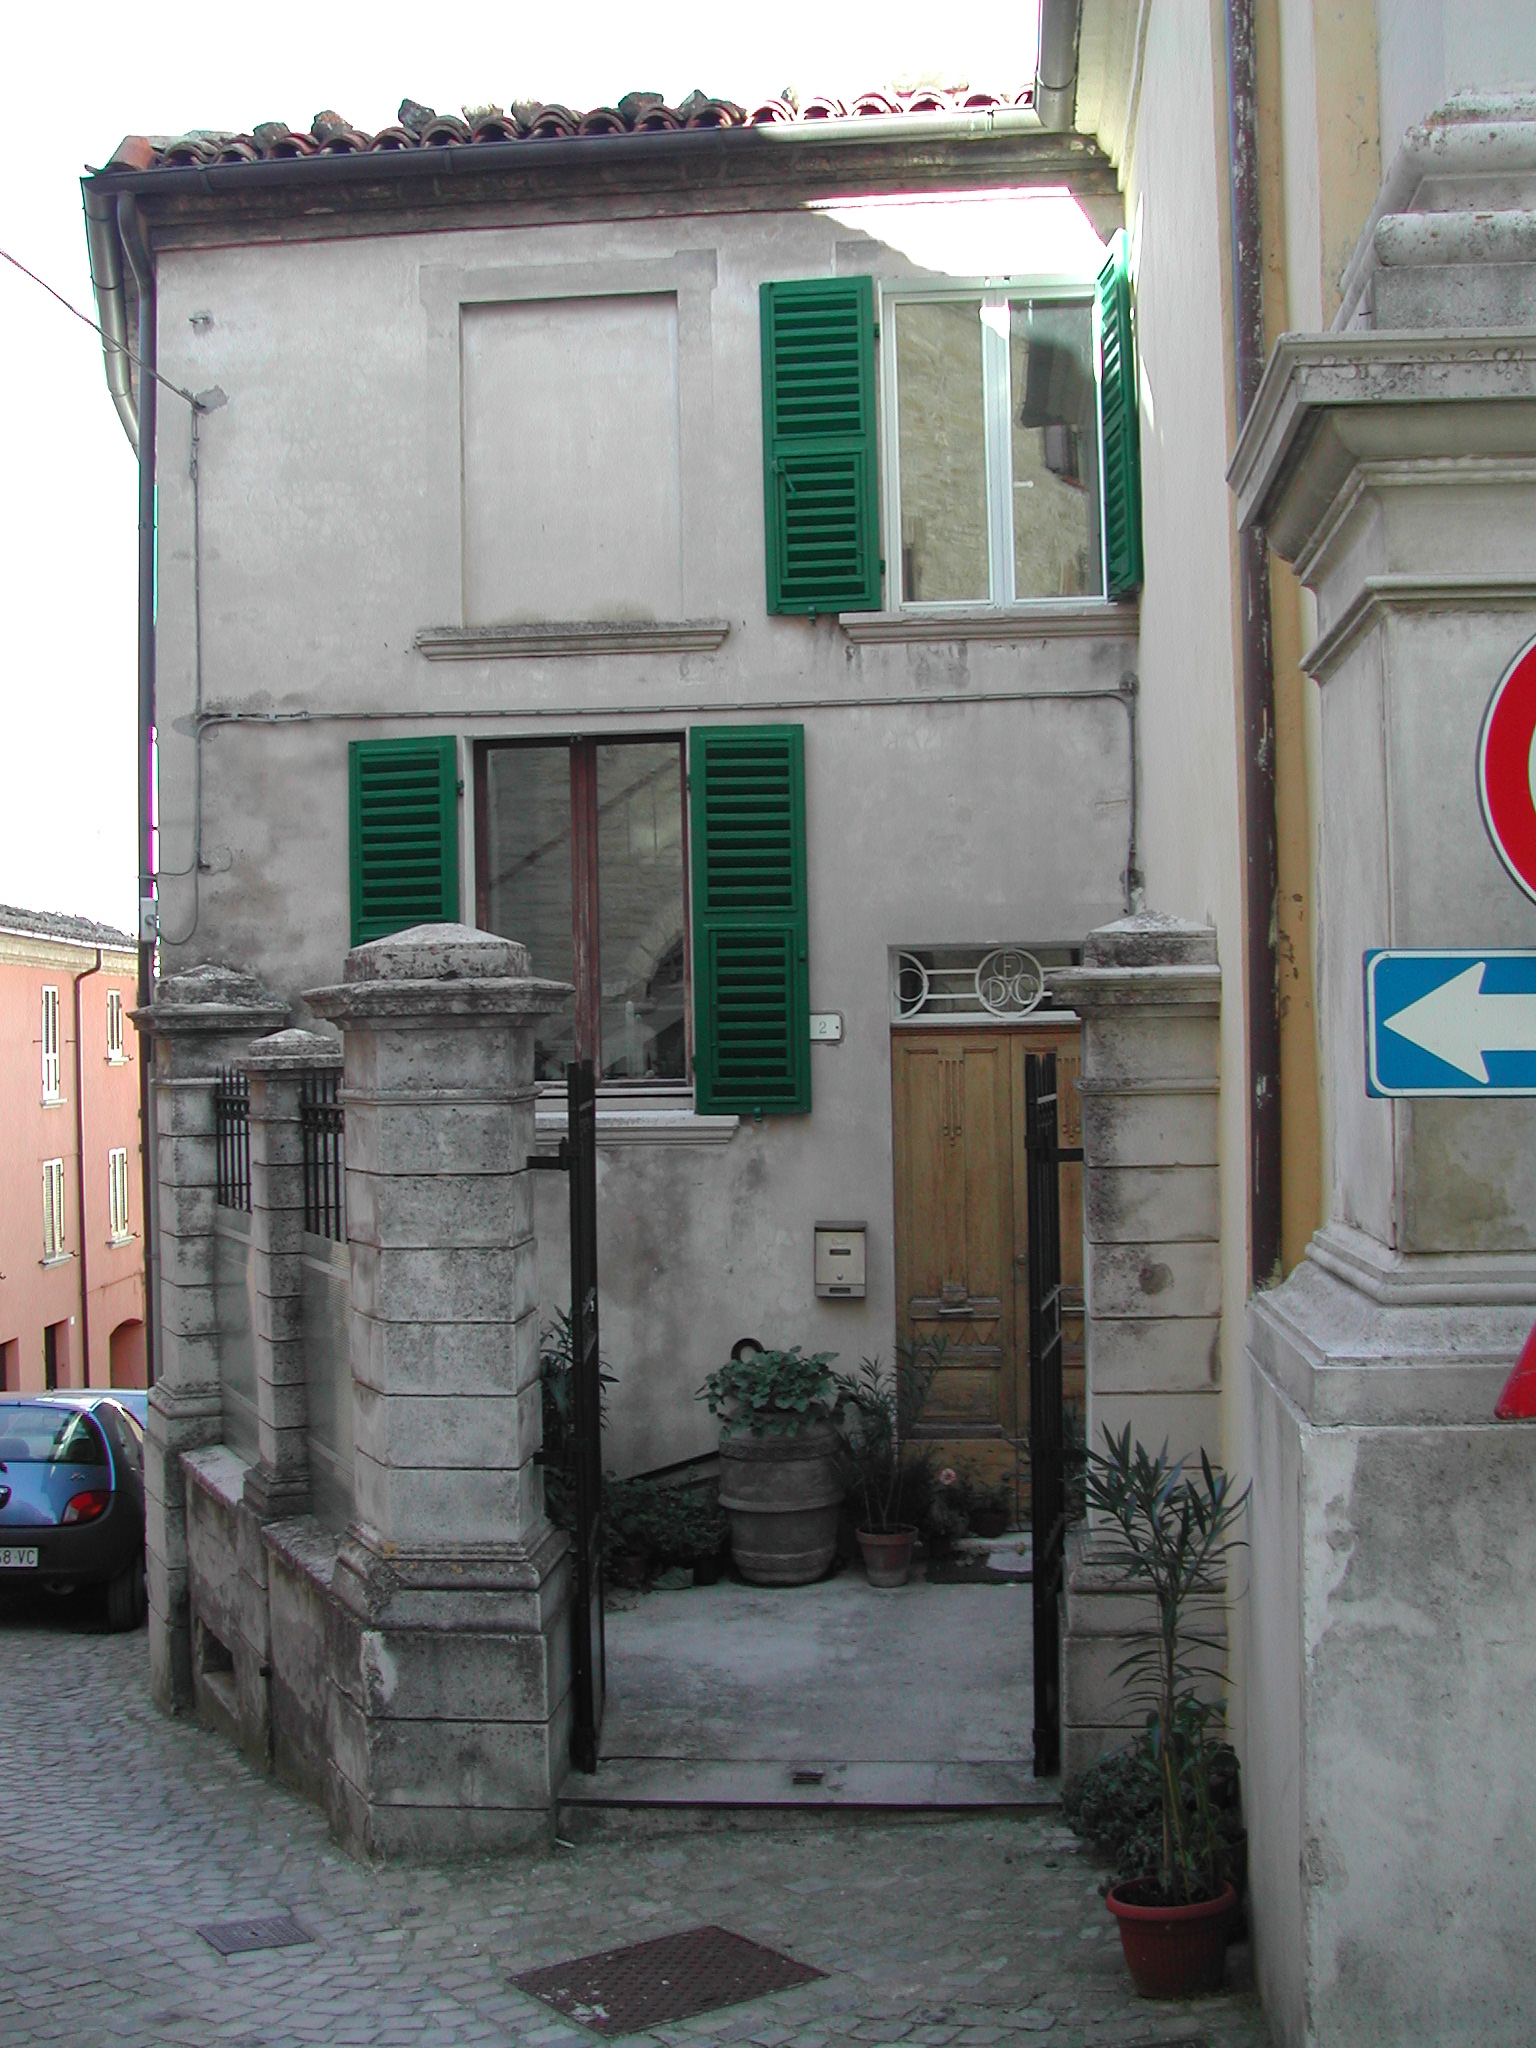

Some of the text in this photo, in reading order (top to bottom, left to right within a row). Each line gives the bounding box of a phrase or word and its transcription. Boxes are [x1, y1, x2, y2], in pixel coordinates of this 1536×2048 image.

[818, 1021, 828, 1034] 2
[0, 1550, 35, 1564] 8 VC
